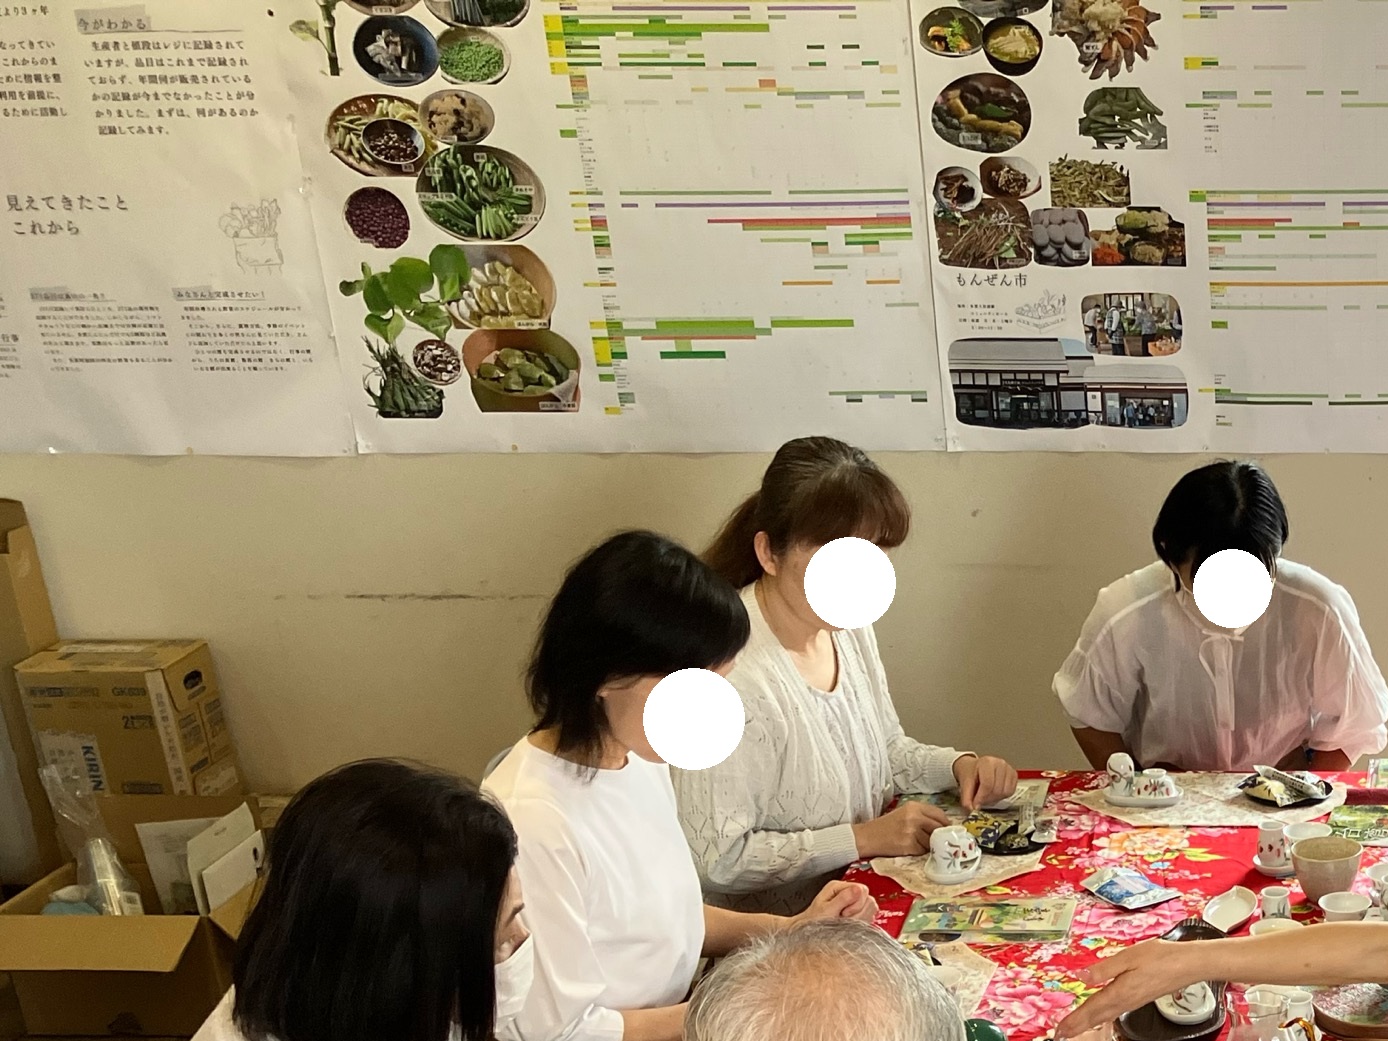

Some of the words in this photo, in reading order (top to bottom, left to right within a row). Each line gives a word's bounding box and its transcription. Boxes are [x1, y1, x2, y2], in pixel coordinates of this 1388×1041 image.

[78, 18, 146, 30] 今がわかる
[6, 194, 129, 212] 見えてきたこと
[13, 220, 80, 237] これから
[956, 272, 1028, 288] もんぜん市
[81, 745, 105, 792] KIRIN
